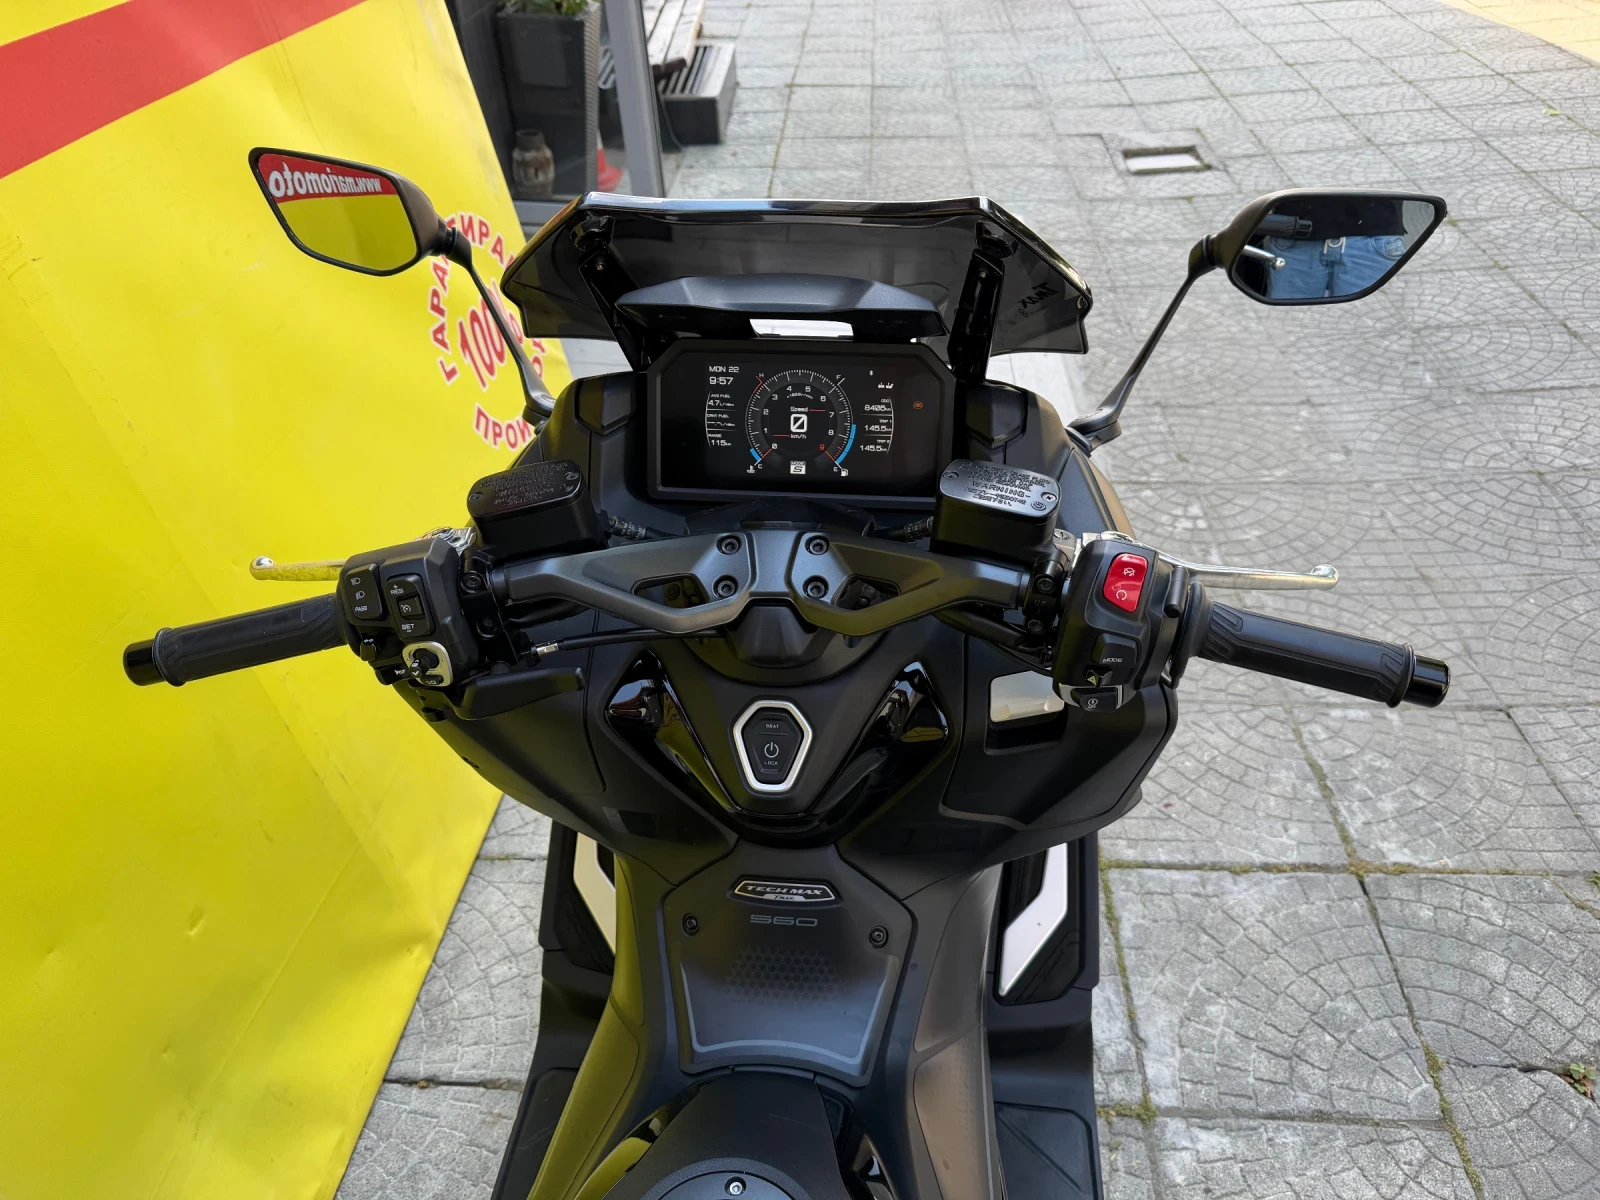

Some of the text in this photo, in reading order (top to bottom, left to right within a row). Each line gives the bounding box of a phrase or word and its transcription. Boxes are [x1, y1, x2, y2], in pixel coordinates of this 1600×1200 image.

[709, 376, 734, 385] 9:57
[790, 413, 808, 433] 0
[745, 885, 788, 894] TECH
[749, 914, 818, 927] 560
